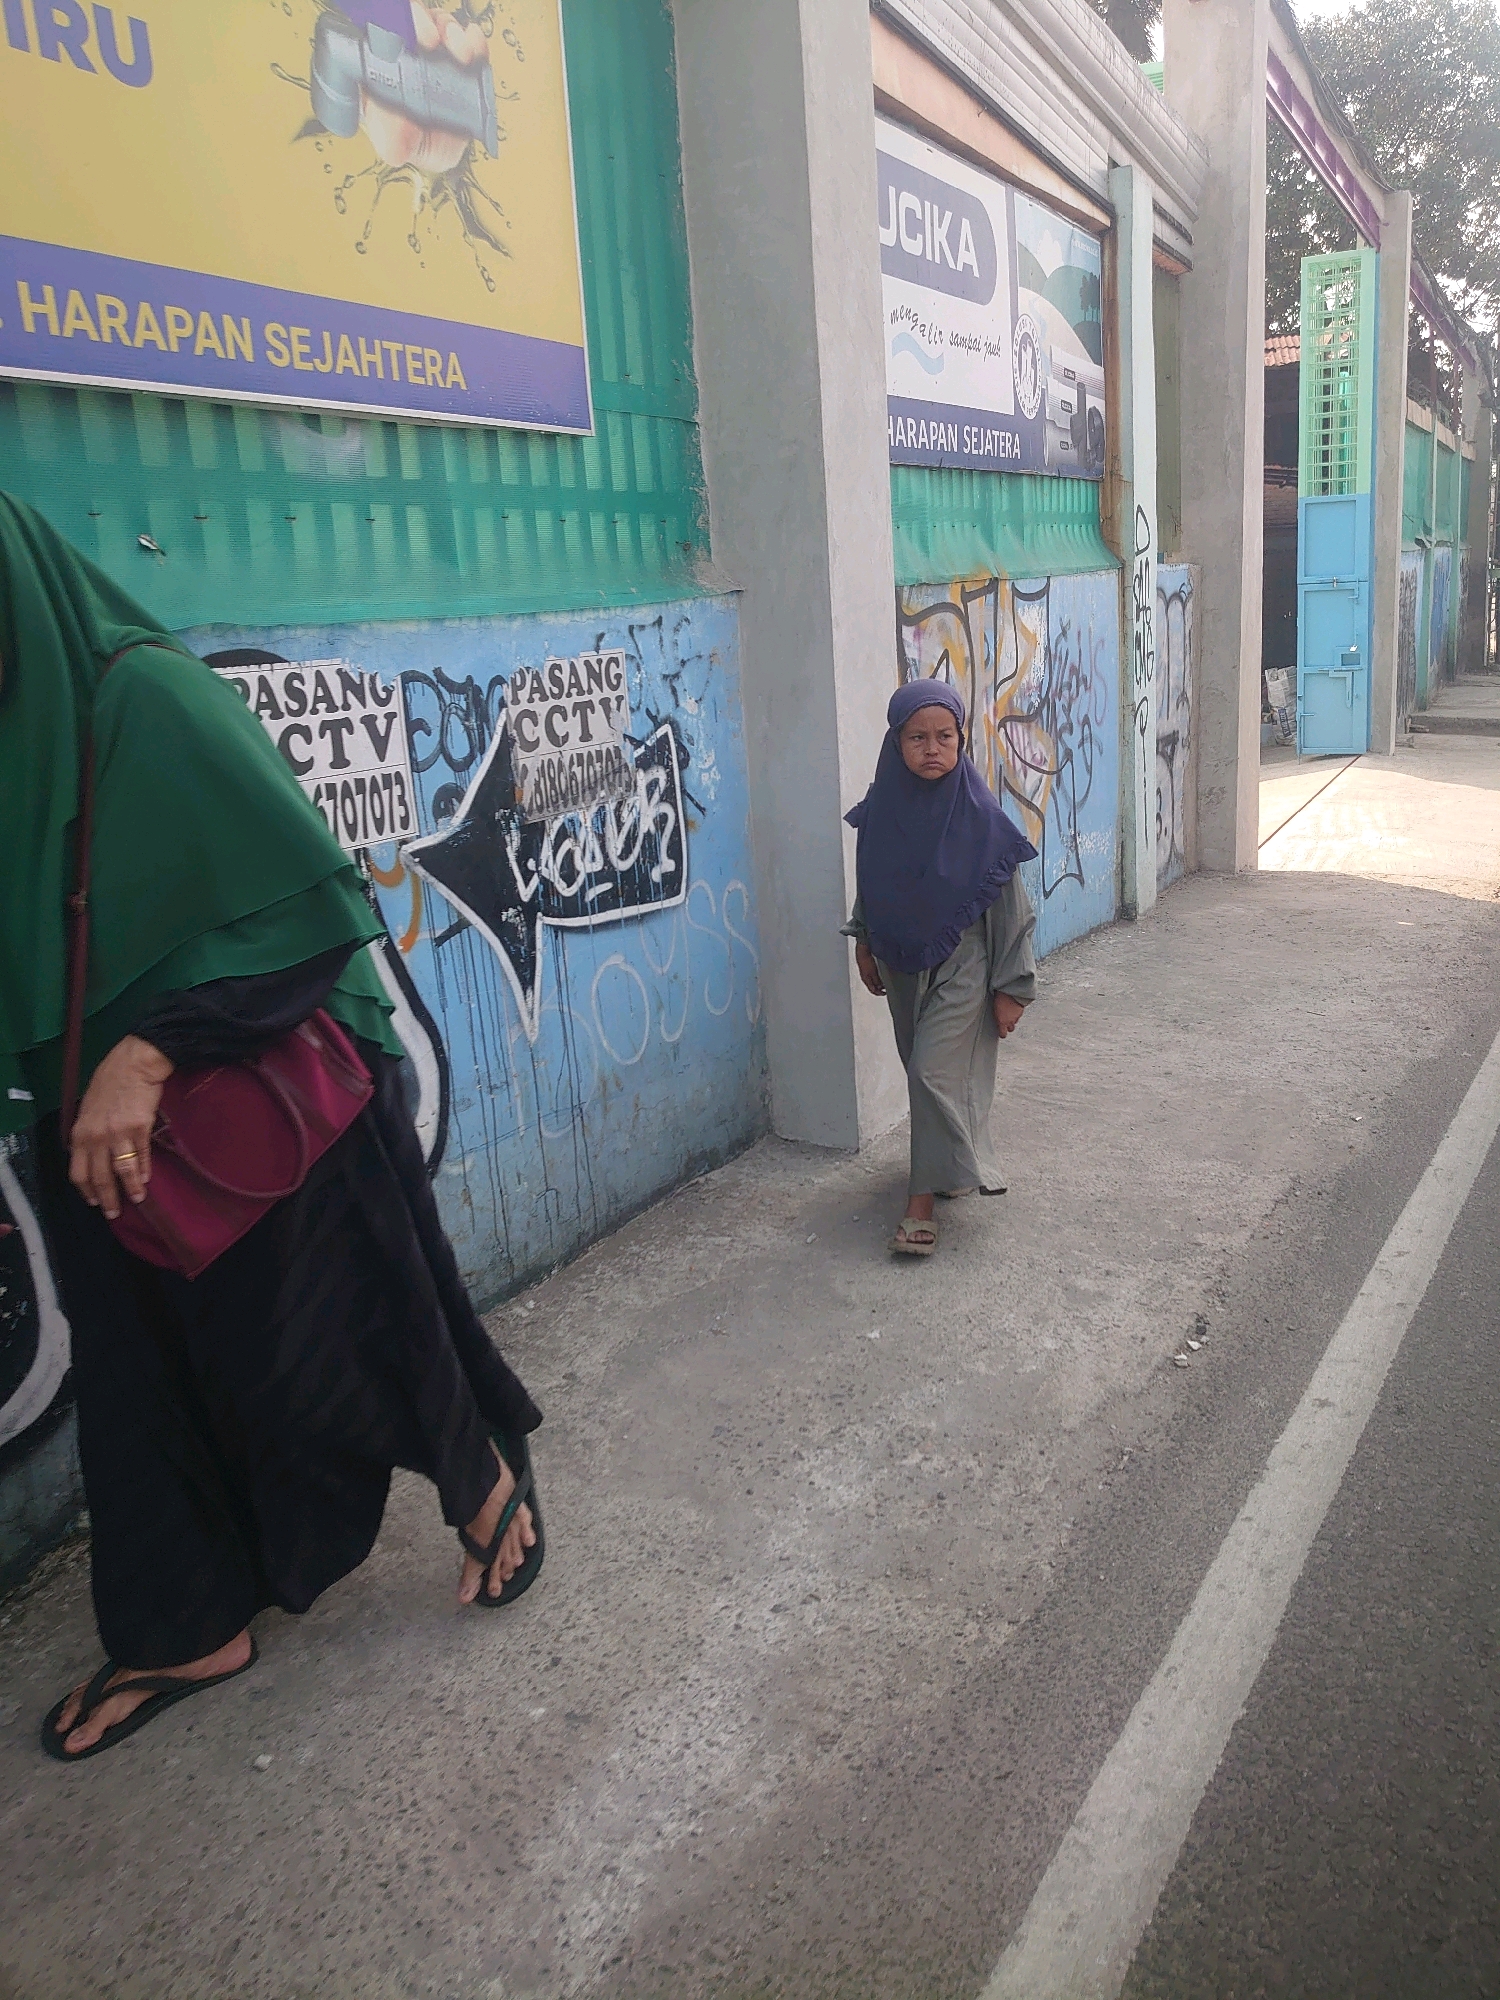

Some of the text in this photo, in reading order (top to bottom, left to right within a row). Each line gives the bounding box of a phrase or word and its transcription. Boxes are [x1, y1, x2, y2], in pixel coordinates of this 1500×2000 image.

[2, 0, 153, 88] IRU
[16, 280, 467, 390] HARAPAN SEJAHTERA
[890, 304, 943, 345] mengalir
[949, 331, 981, 357] sampai
[963, 424, 1021, 459] SEJATERA
[510, 656, 623, 705] PASANG
